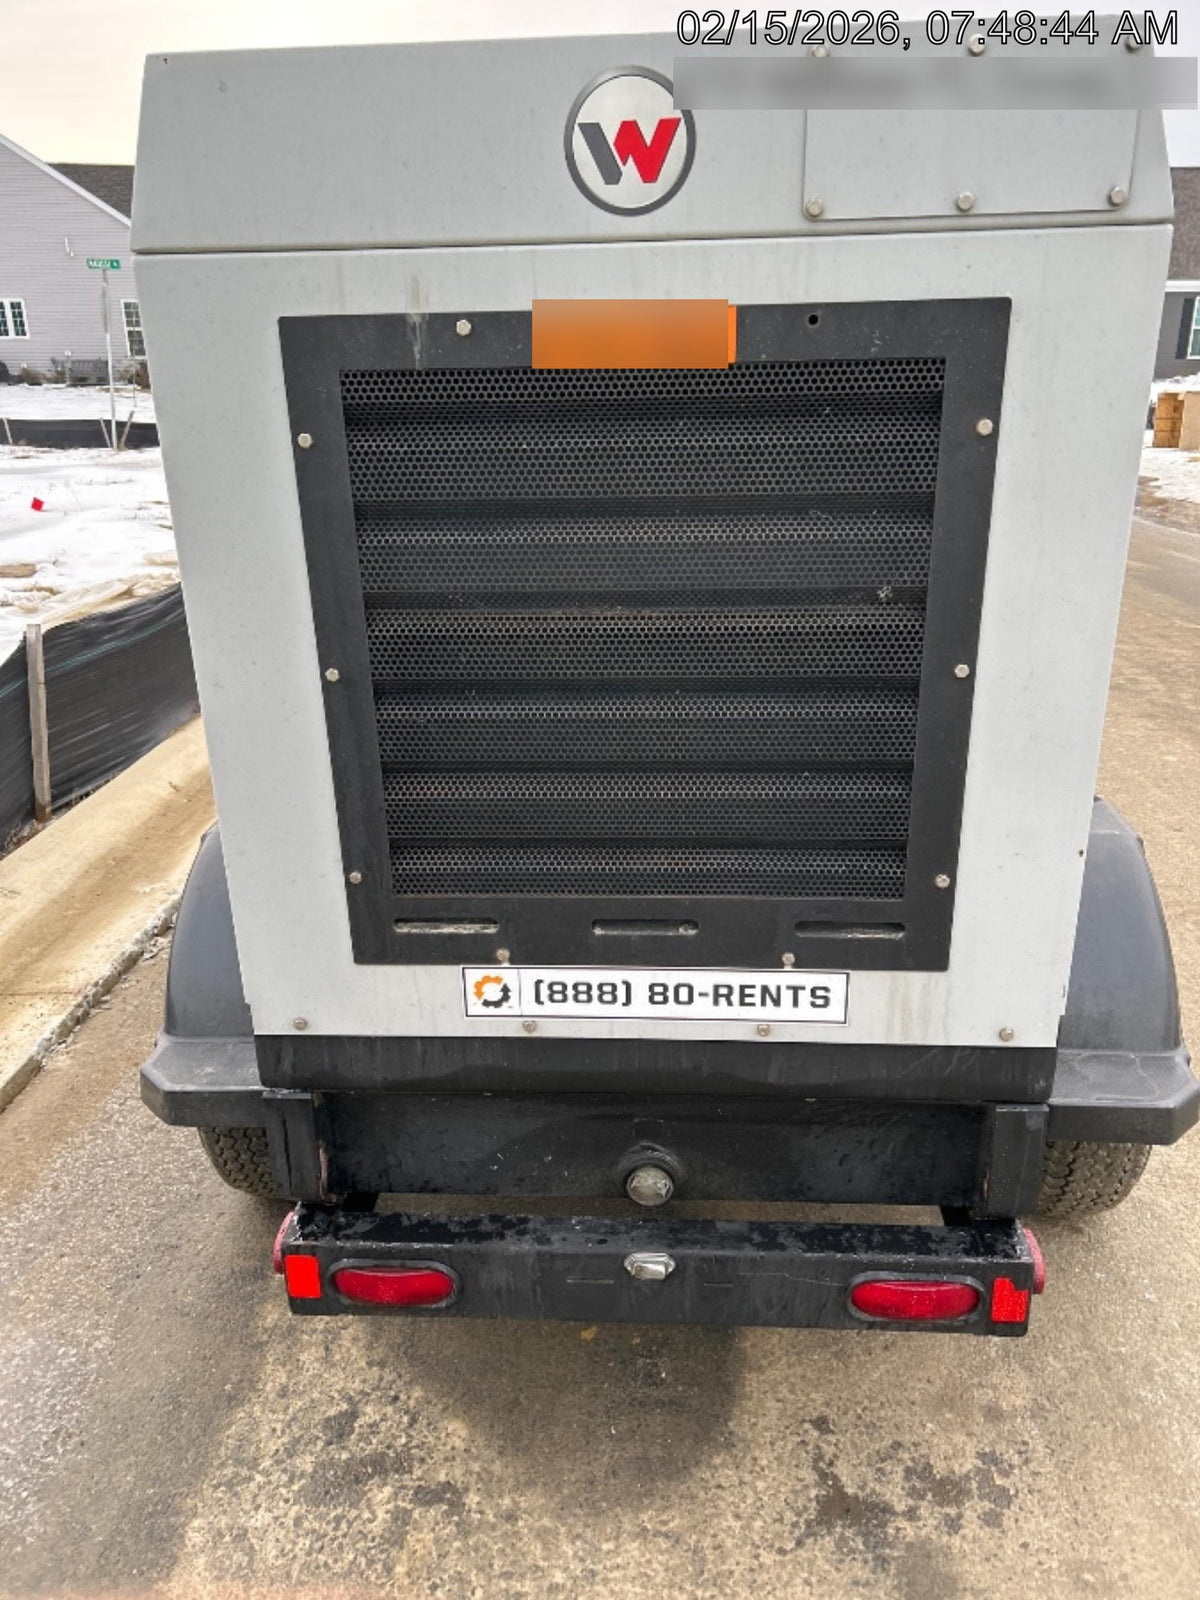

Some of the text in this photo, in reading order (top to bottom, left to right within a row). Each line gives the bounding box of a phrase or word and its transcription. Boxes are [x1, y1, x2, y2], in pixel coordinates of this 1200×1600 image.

[577, 117, 681, 185] W
[534, 980, 831, 1009] (888) 80-RENTS
